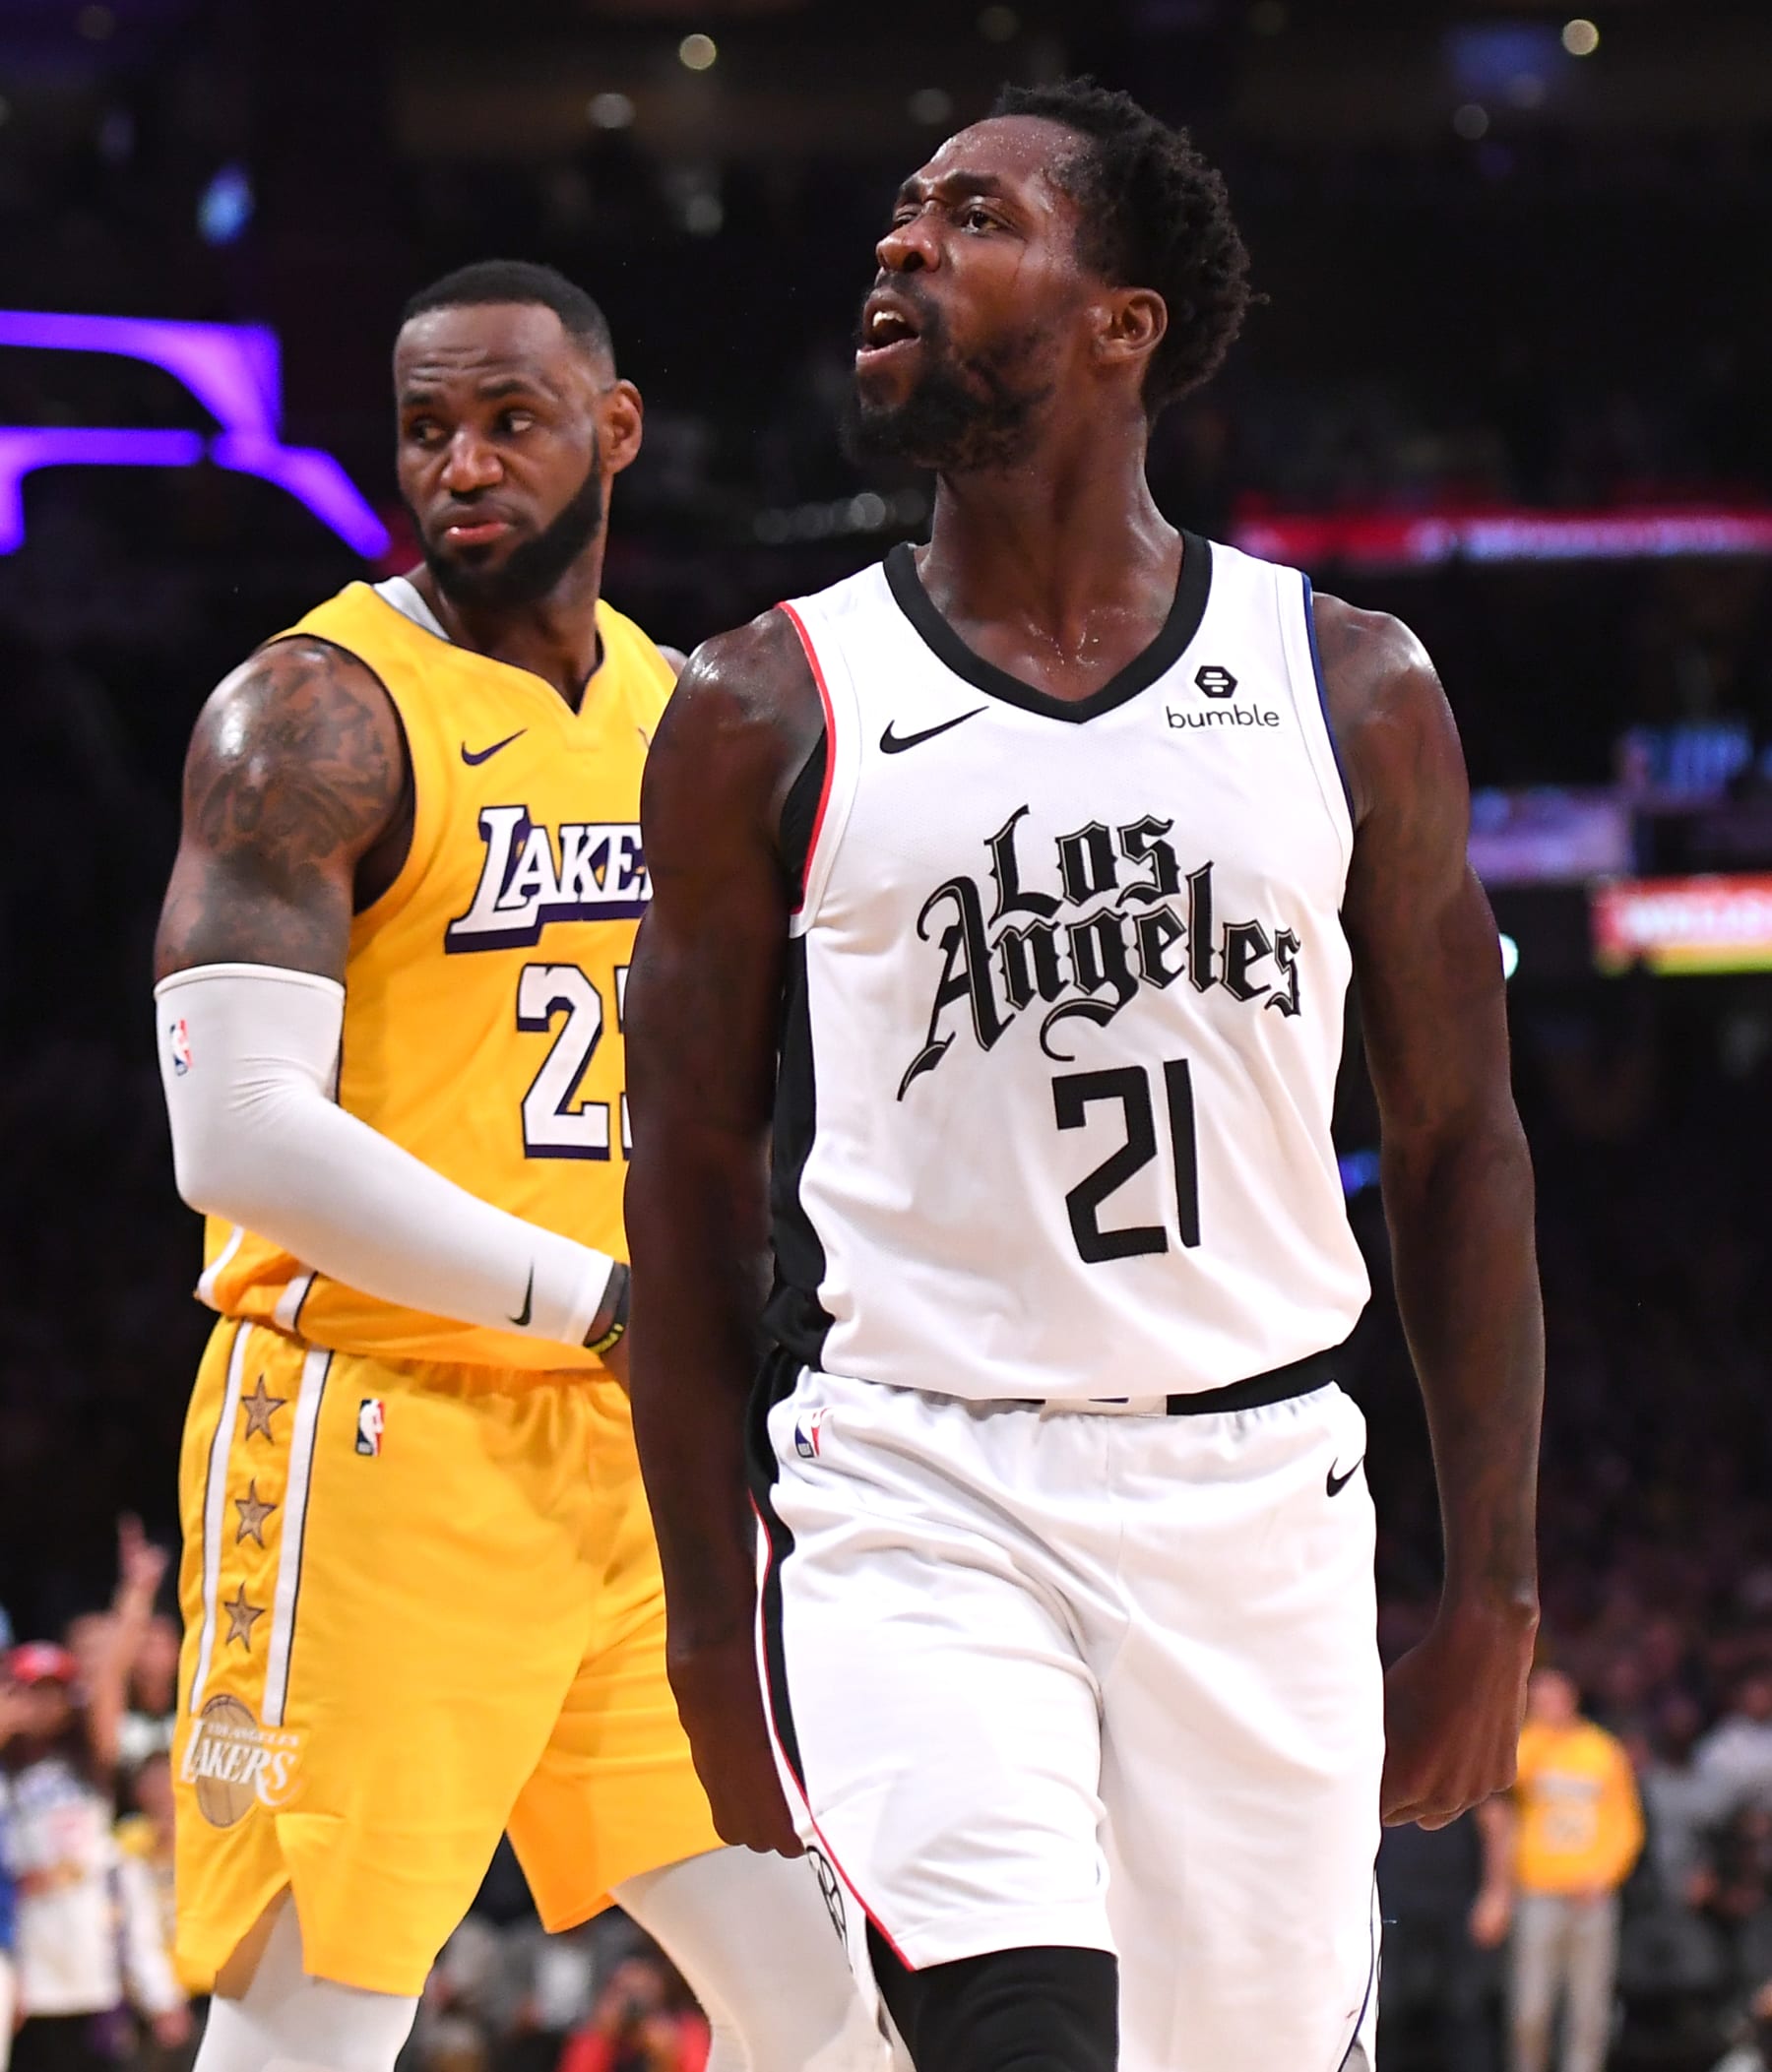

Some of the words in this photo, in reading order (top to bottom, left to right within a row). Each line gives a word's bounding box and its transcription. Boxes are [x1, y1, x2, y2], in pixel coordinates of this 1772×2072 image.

[1166, 703, 1280, 728] bumble
[445, 804, 654, 954] LAKE
[984, 804, 1180, 927] Los
[897, 860, 1302, 1102] Angeles
[517, 963, 633, 1162] 2
[1051, 1058, 1201, 1264] 21
[180, 1719, 302, 1806] LAKERS
